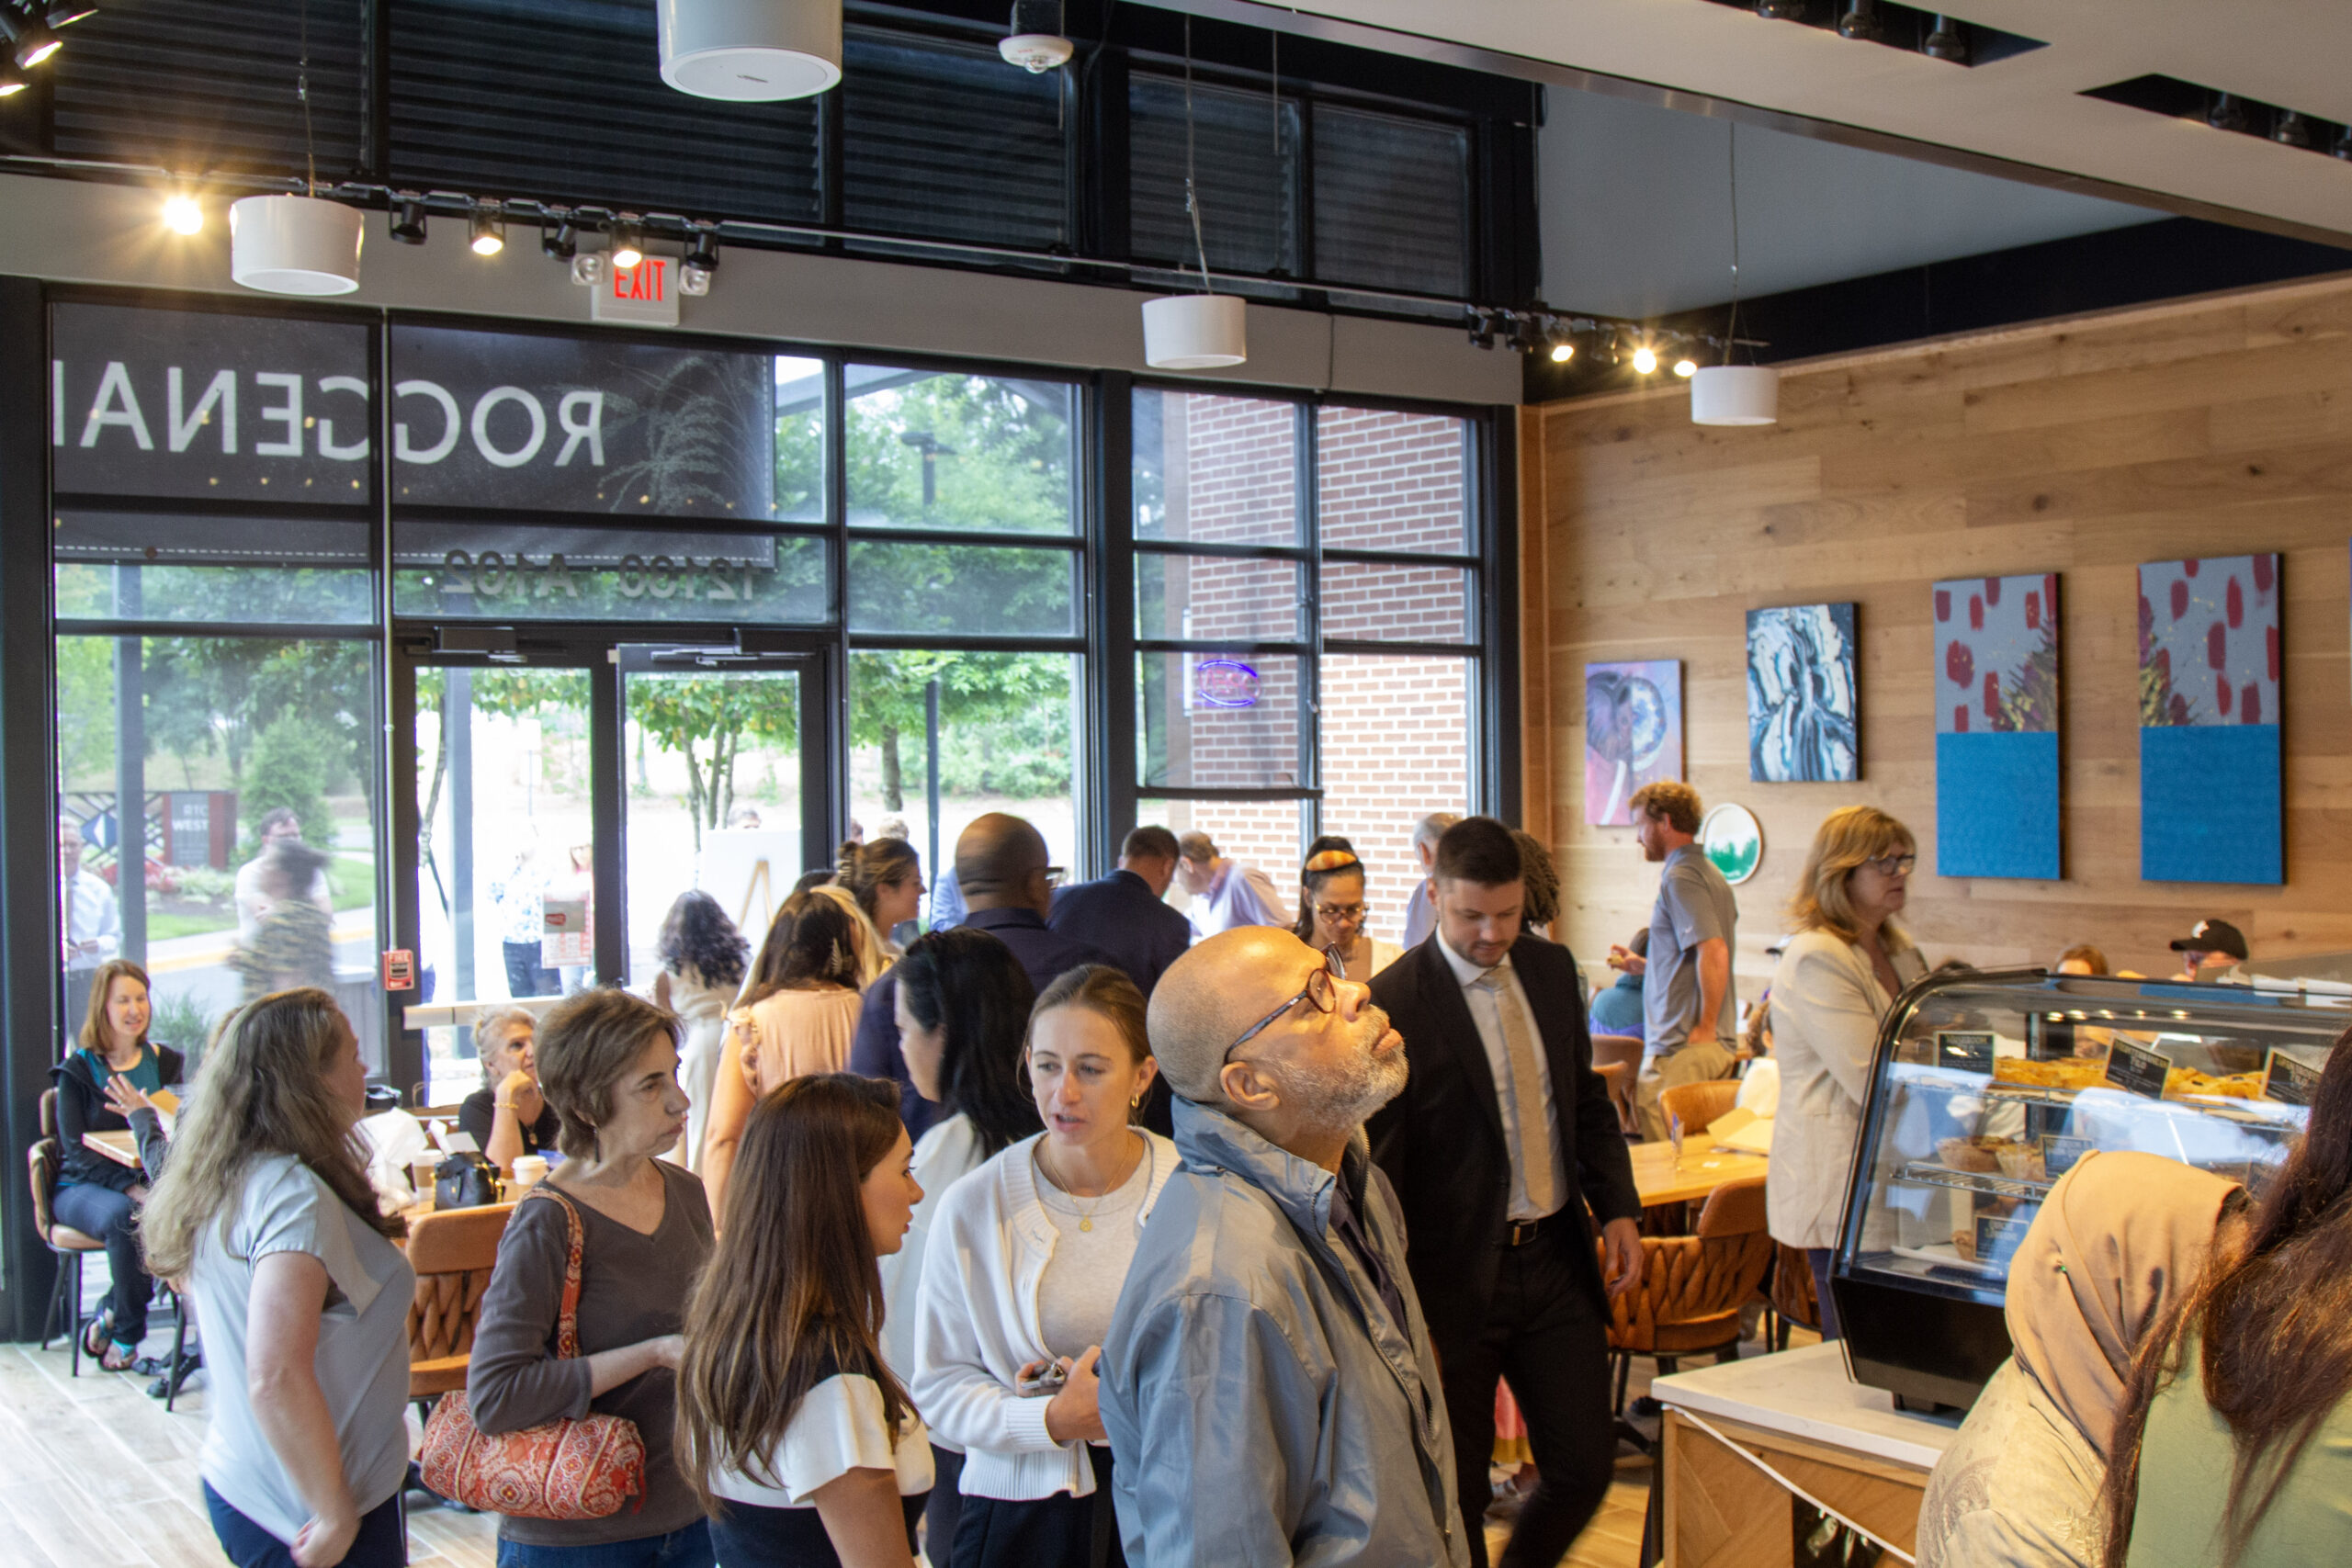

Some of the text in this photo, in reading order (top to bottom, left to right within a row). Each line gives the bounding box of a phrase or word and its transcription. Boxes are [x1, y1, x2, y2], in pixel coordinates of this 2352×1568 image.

[613, 259, 666, 301] EXIT
[183, 804, 209, 817] RTC
[171, 818, 209, 831] WEST
